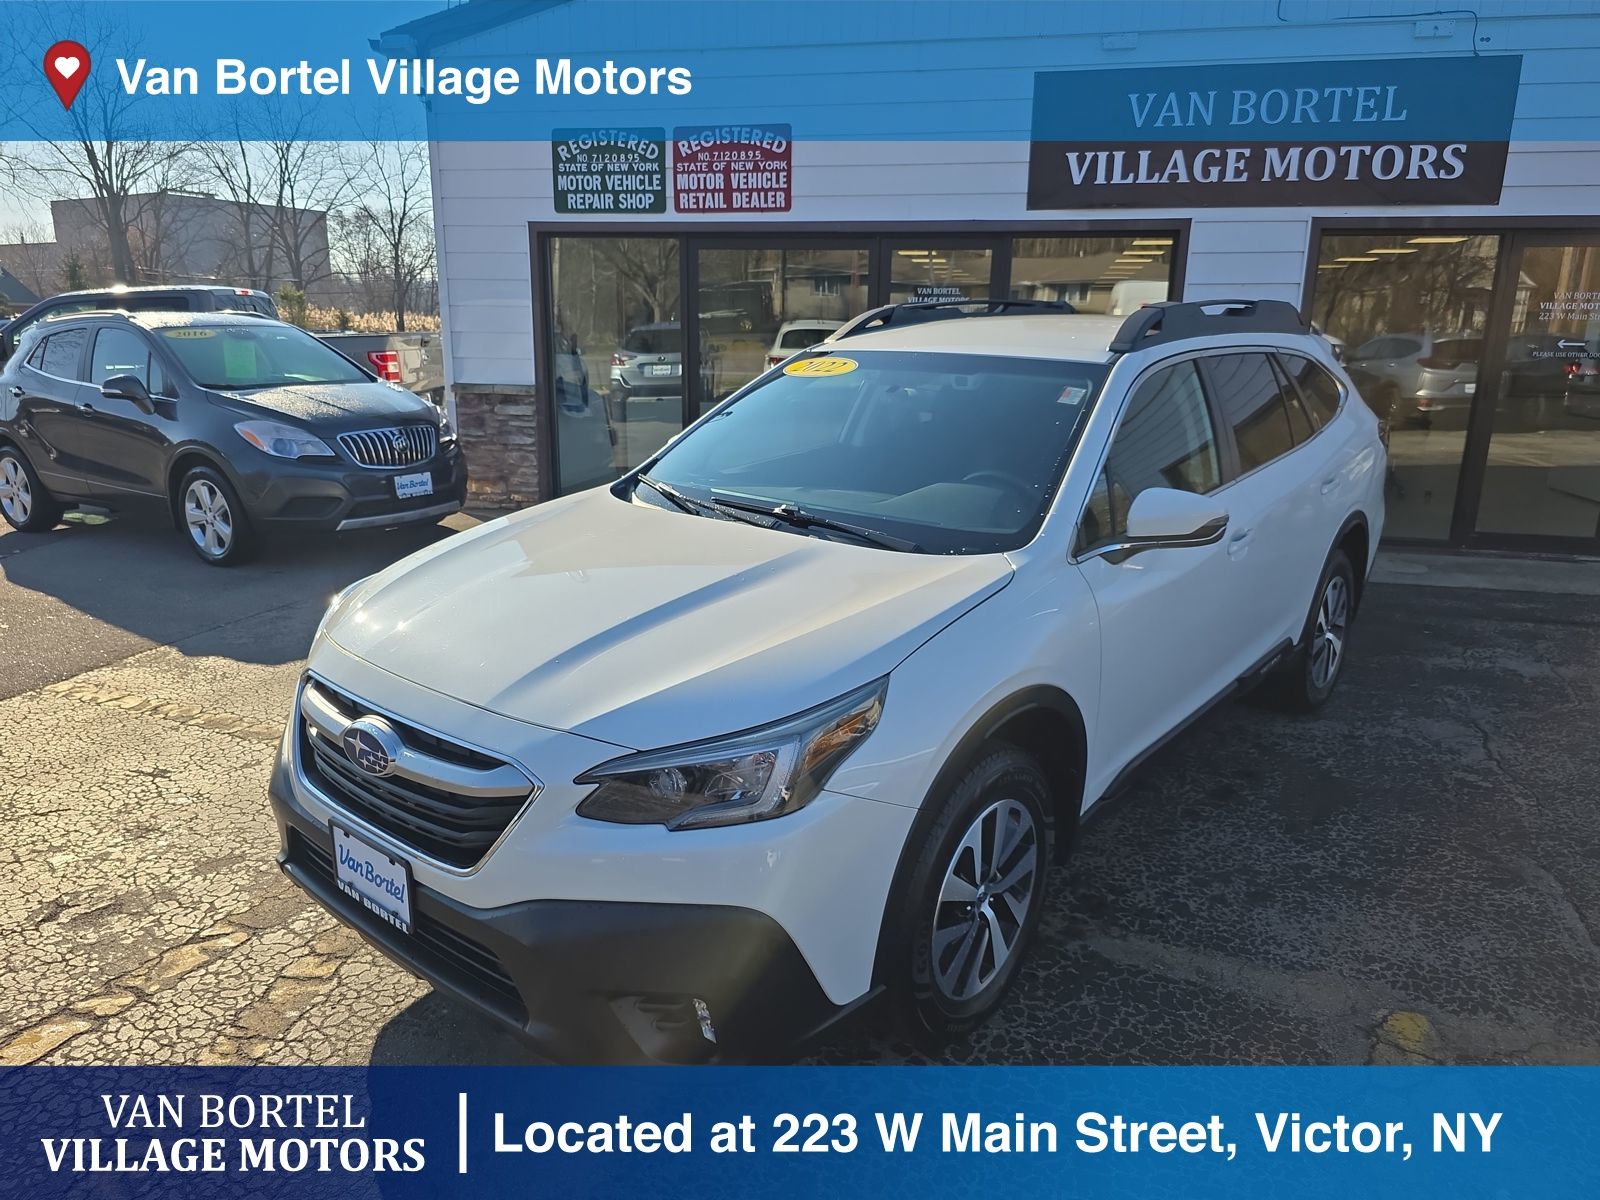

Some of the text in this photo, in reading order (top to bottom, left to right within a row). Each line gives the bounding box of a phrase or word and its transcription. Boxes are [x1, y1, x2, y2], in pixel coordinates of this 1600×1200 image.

[1128, 86, 1408, 128] VAN BORTEL
[557, 129, 660, 161] REGISTERED
[677, 127, 788, 158] REGISTERED
[592, 153, 640, 163] 7120895
[713, 151, 762, 161] 7120895
[558, 162, 660, 172] STATE OF NEW YORK
[676, 161, 788, 172] STATE OF NEW YORK
[1066, 144, 1468, 186] VILLAGE MOTORS
[557, 174, 662, 191] MOTOR VEHICLE
[676, 172, 788, 190] MOTOR VEHICLE
[567, 193, 655, 209] REPAIR SHOP
[679, 191, 786, 209] RETAIL DEALER
[1540, 302, 1578, 310] VILLAGE
[1539, 312, 1554, 320] 223
[1567, 312, 1588, 320] Main
[791, 361, 848, 373] 2022
[339, 844, 405, 903] Van Bortel
